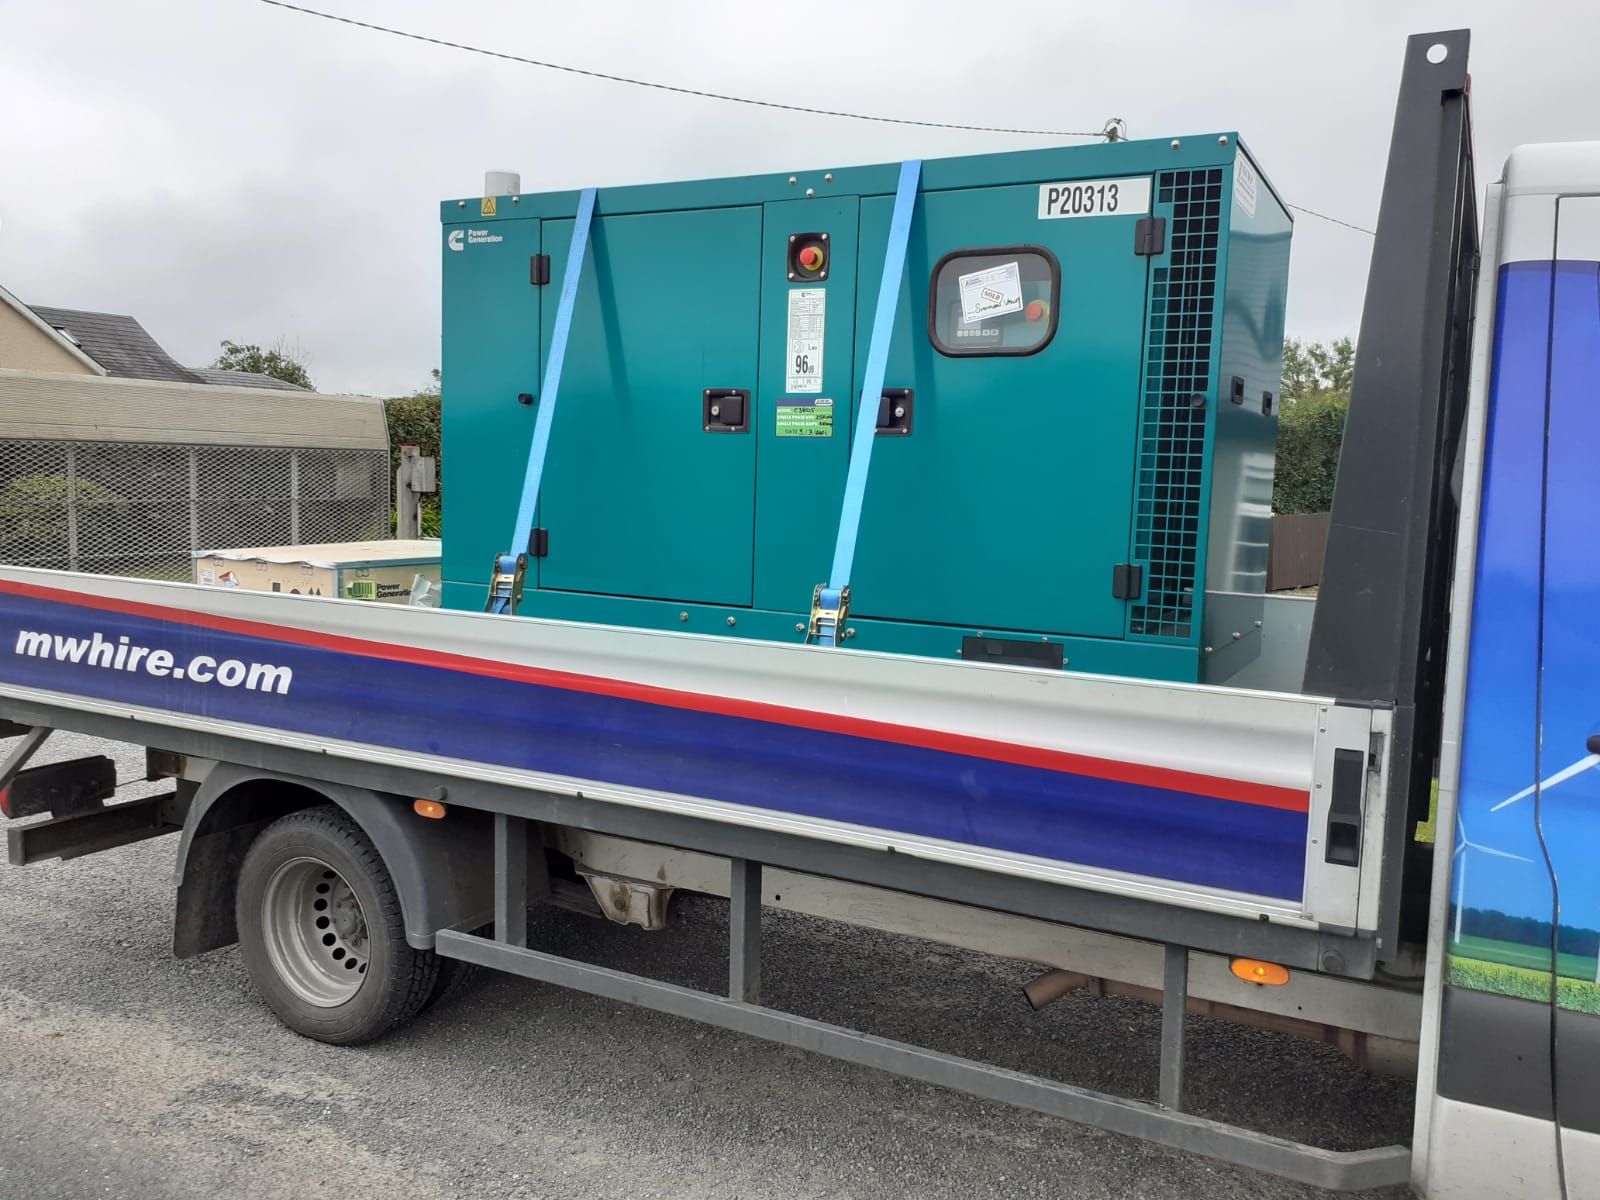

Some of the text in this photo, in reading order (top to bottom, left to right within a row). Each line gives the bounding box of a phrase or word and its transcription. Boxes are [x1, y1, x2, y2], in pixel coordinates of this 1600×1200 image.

[1047, 184, 1119, 215] P20313
[984, 291, 1001, 301] SOLD
[796, 355, 808, 373] 96
[377, 589, 412, 598] Generati
[15, 630, 293, 695] mwhire.com
